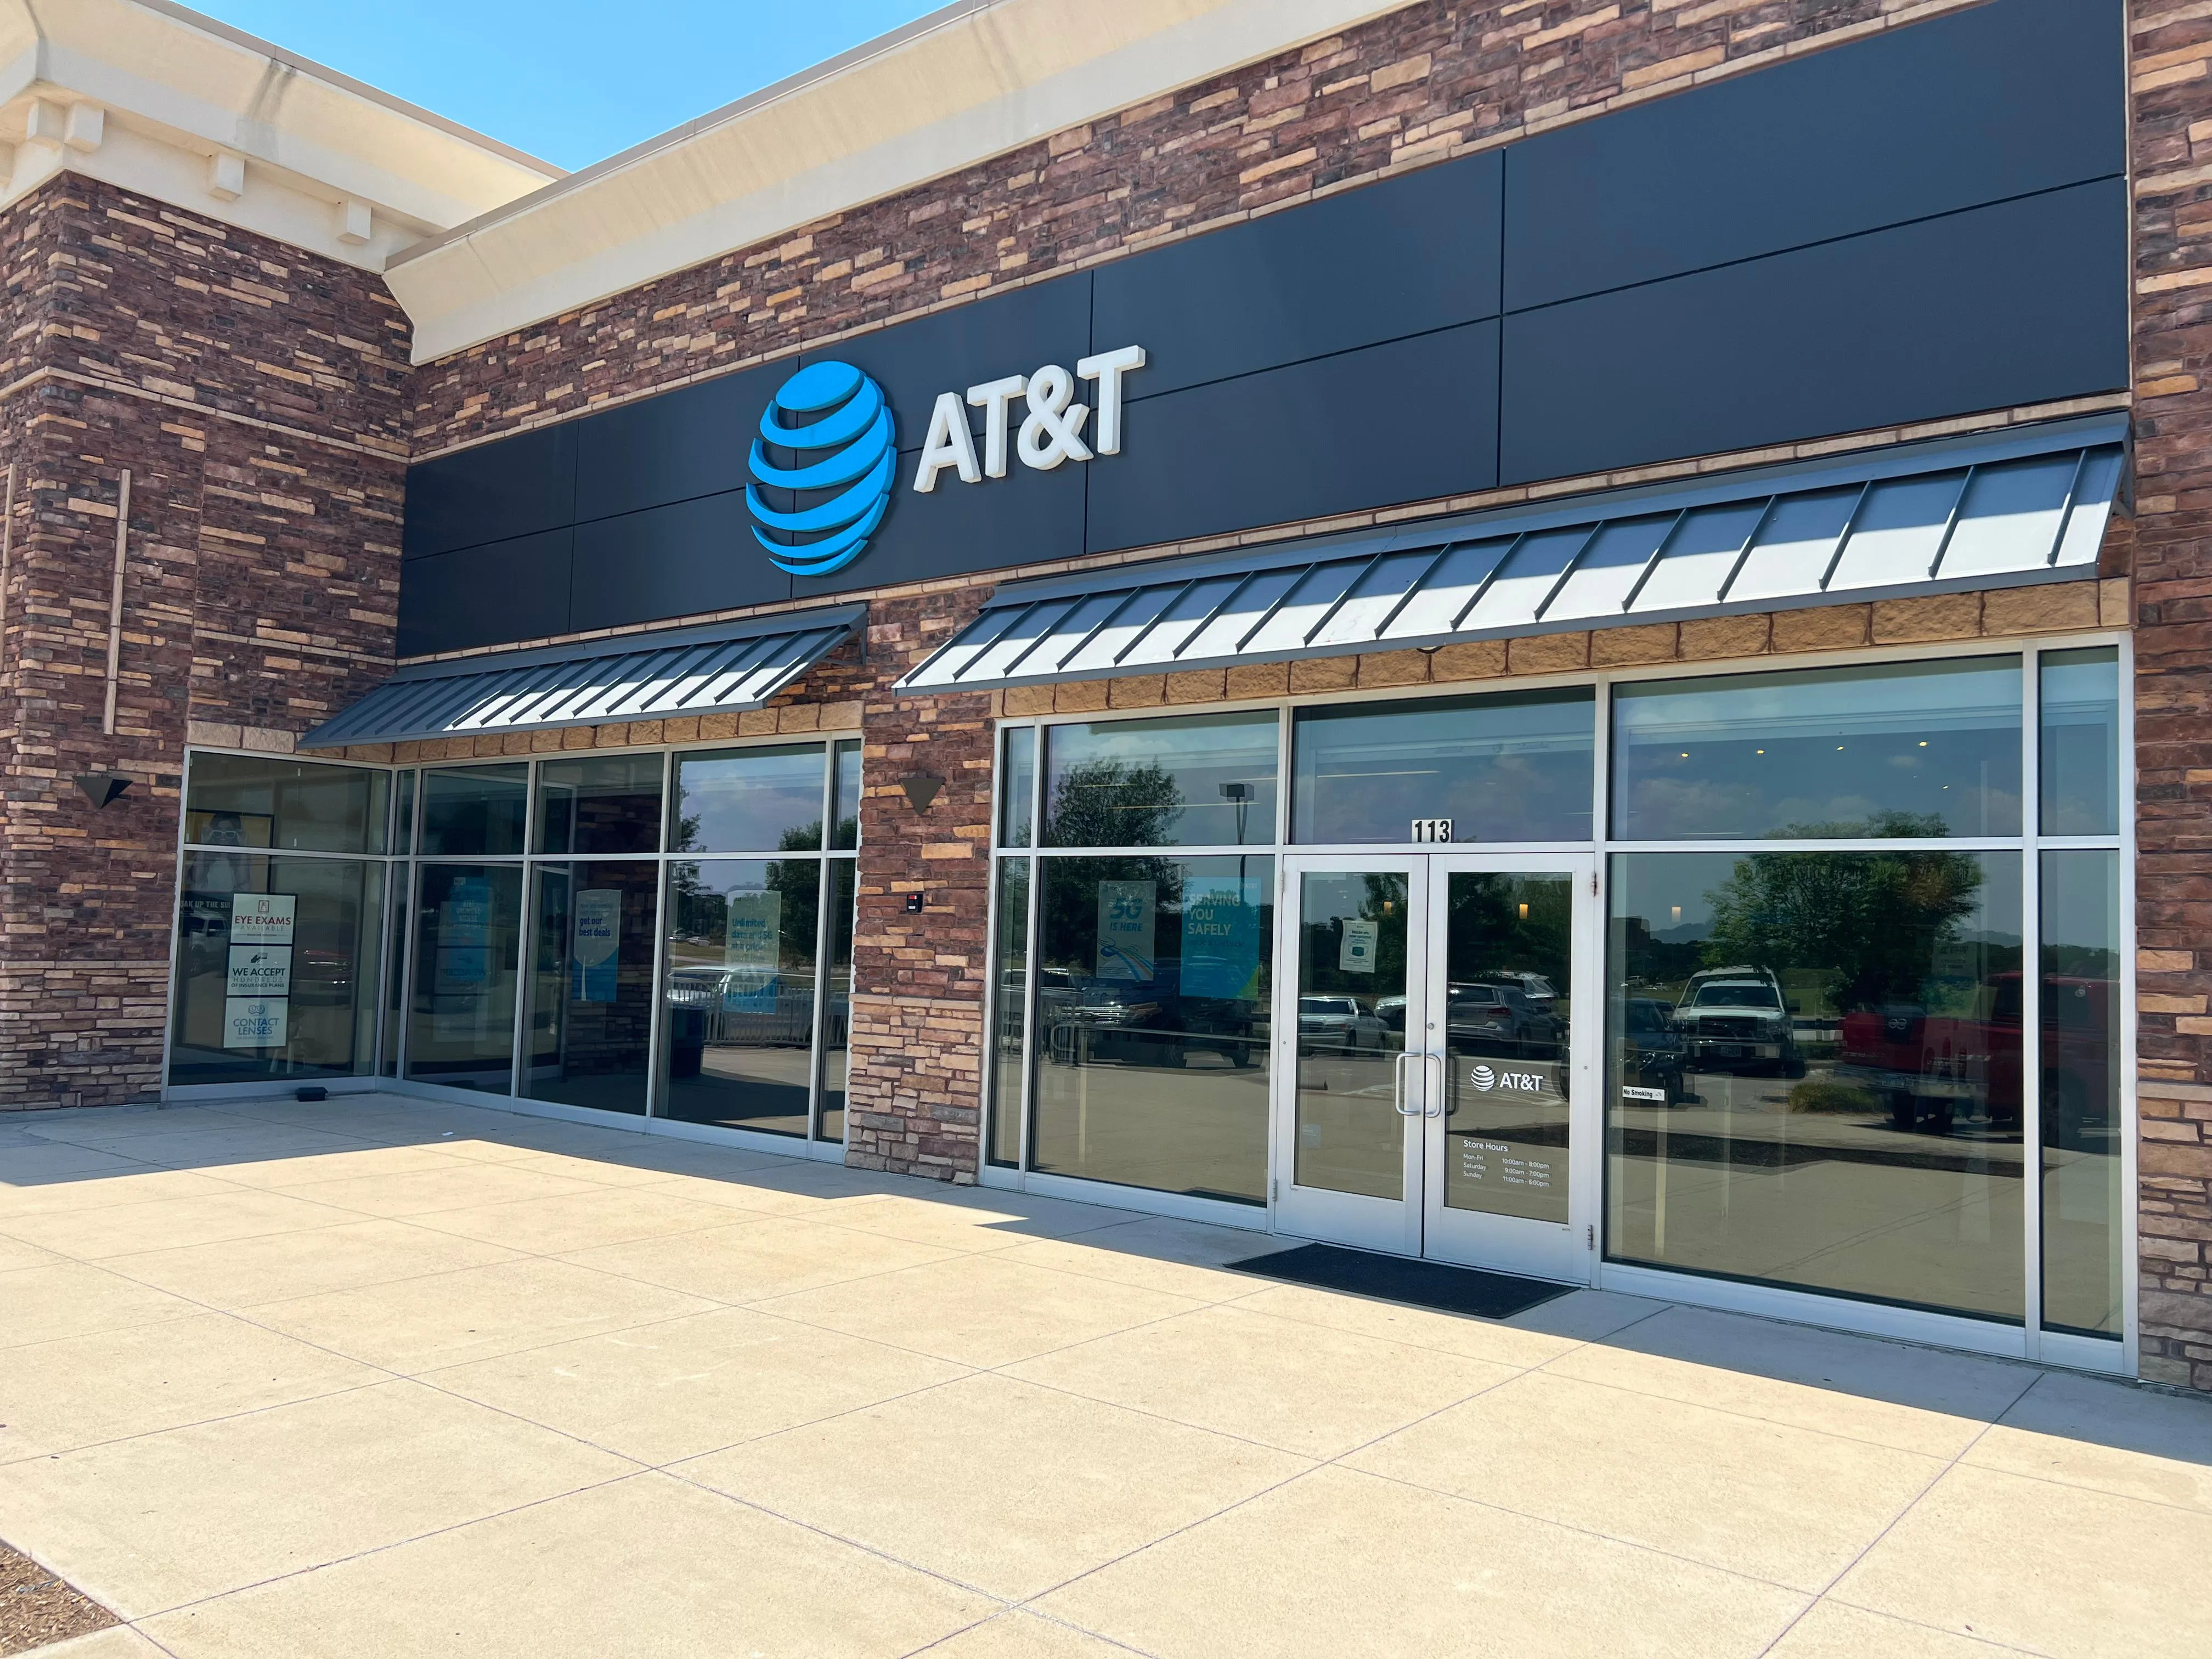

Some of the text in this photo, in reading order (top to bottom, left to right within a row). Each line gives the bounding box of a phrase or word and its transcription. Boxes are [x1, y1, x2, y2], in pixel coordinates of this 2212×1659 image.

[913, 345, 1146, 493] AT&T
[1415, 820, 1449, 843] 113
[1189, 894, 1240, 906] SERVING
[1110, 898, 1143, 919] 5G
[1189, 909, 1214, 921] YOU
[235, 916, 291, 926] EYE EXAMS
[580, 917, 590, 927] get
[732, 918, 766, 927] Unlimited
[579, 927, 611, 936] best deals
[1110, 922, 1143, 932] IS HERE
[1188, 923, 1231, 936] SAFELY
[763, 931, 773, 940] 5G
[232, 968, 286, 976] WE ACCEPT
[233, 1018, 279, 1026] CONTACT
[238, 1026, 273, 1035] LENSES
[1499, 1073, 1543, 1091] AT&T
[1631, 1089, 1653, 1098] Smoking
[1463, 1139, 1508, 1152] Store Hours
[1502, 1158, 1524, 1166] 10:00am
[1528, 1161, 1549, 1169] 8:00pm
[1463, 1162, 1487, 1171] Saturday
[1528, 1170, 1549, 1178] 7:00pm
[1463, 1171, 1482, 1180] Sunday
[1503, 1176, 1524, 1184] 11:00am
[1528, 1179, 1549, 1188] 6:00pm
